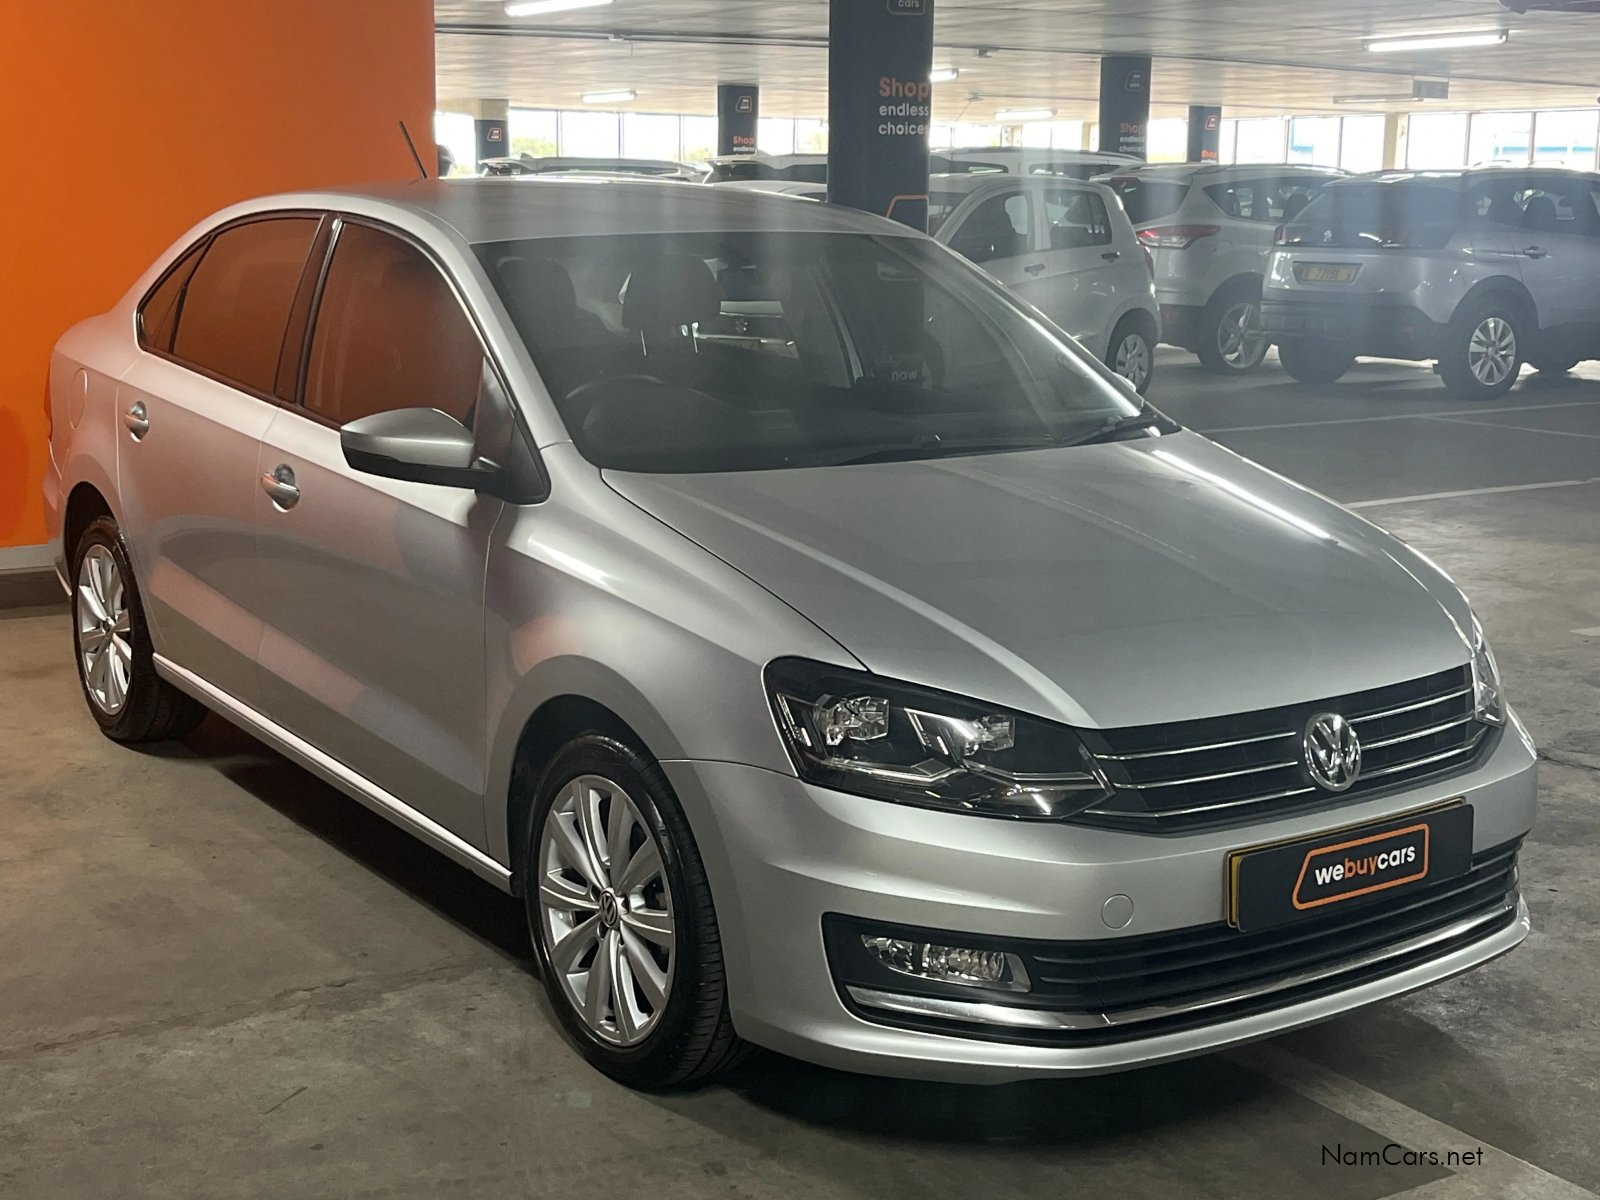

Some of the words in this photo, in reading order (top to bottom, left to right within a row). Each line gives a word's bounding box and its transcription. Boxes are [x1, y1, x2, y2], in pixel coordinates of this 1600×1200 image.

[879, 76, 930, 102] Shop
[878, 103, 929, 116] endless
[733, 135, 755, 145] Shop
[892, 370, 918, 380] now
[1315, 845, 1416, 886] webuycars
